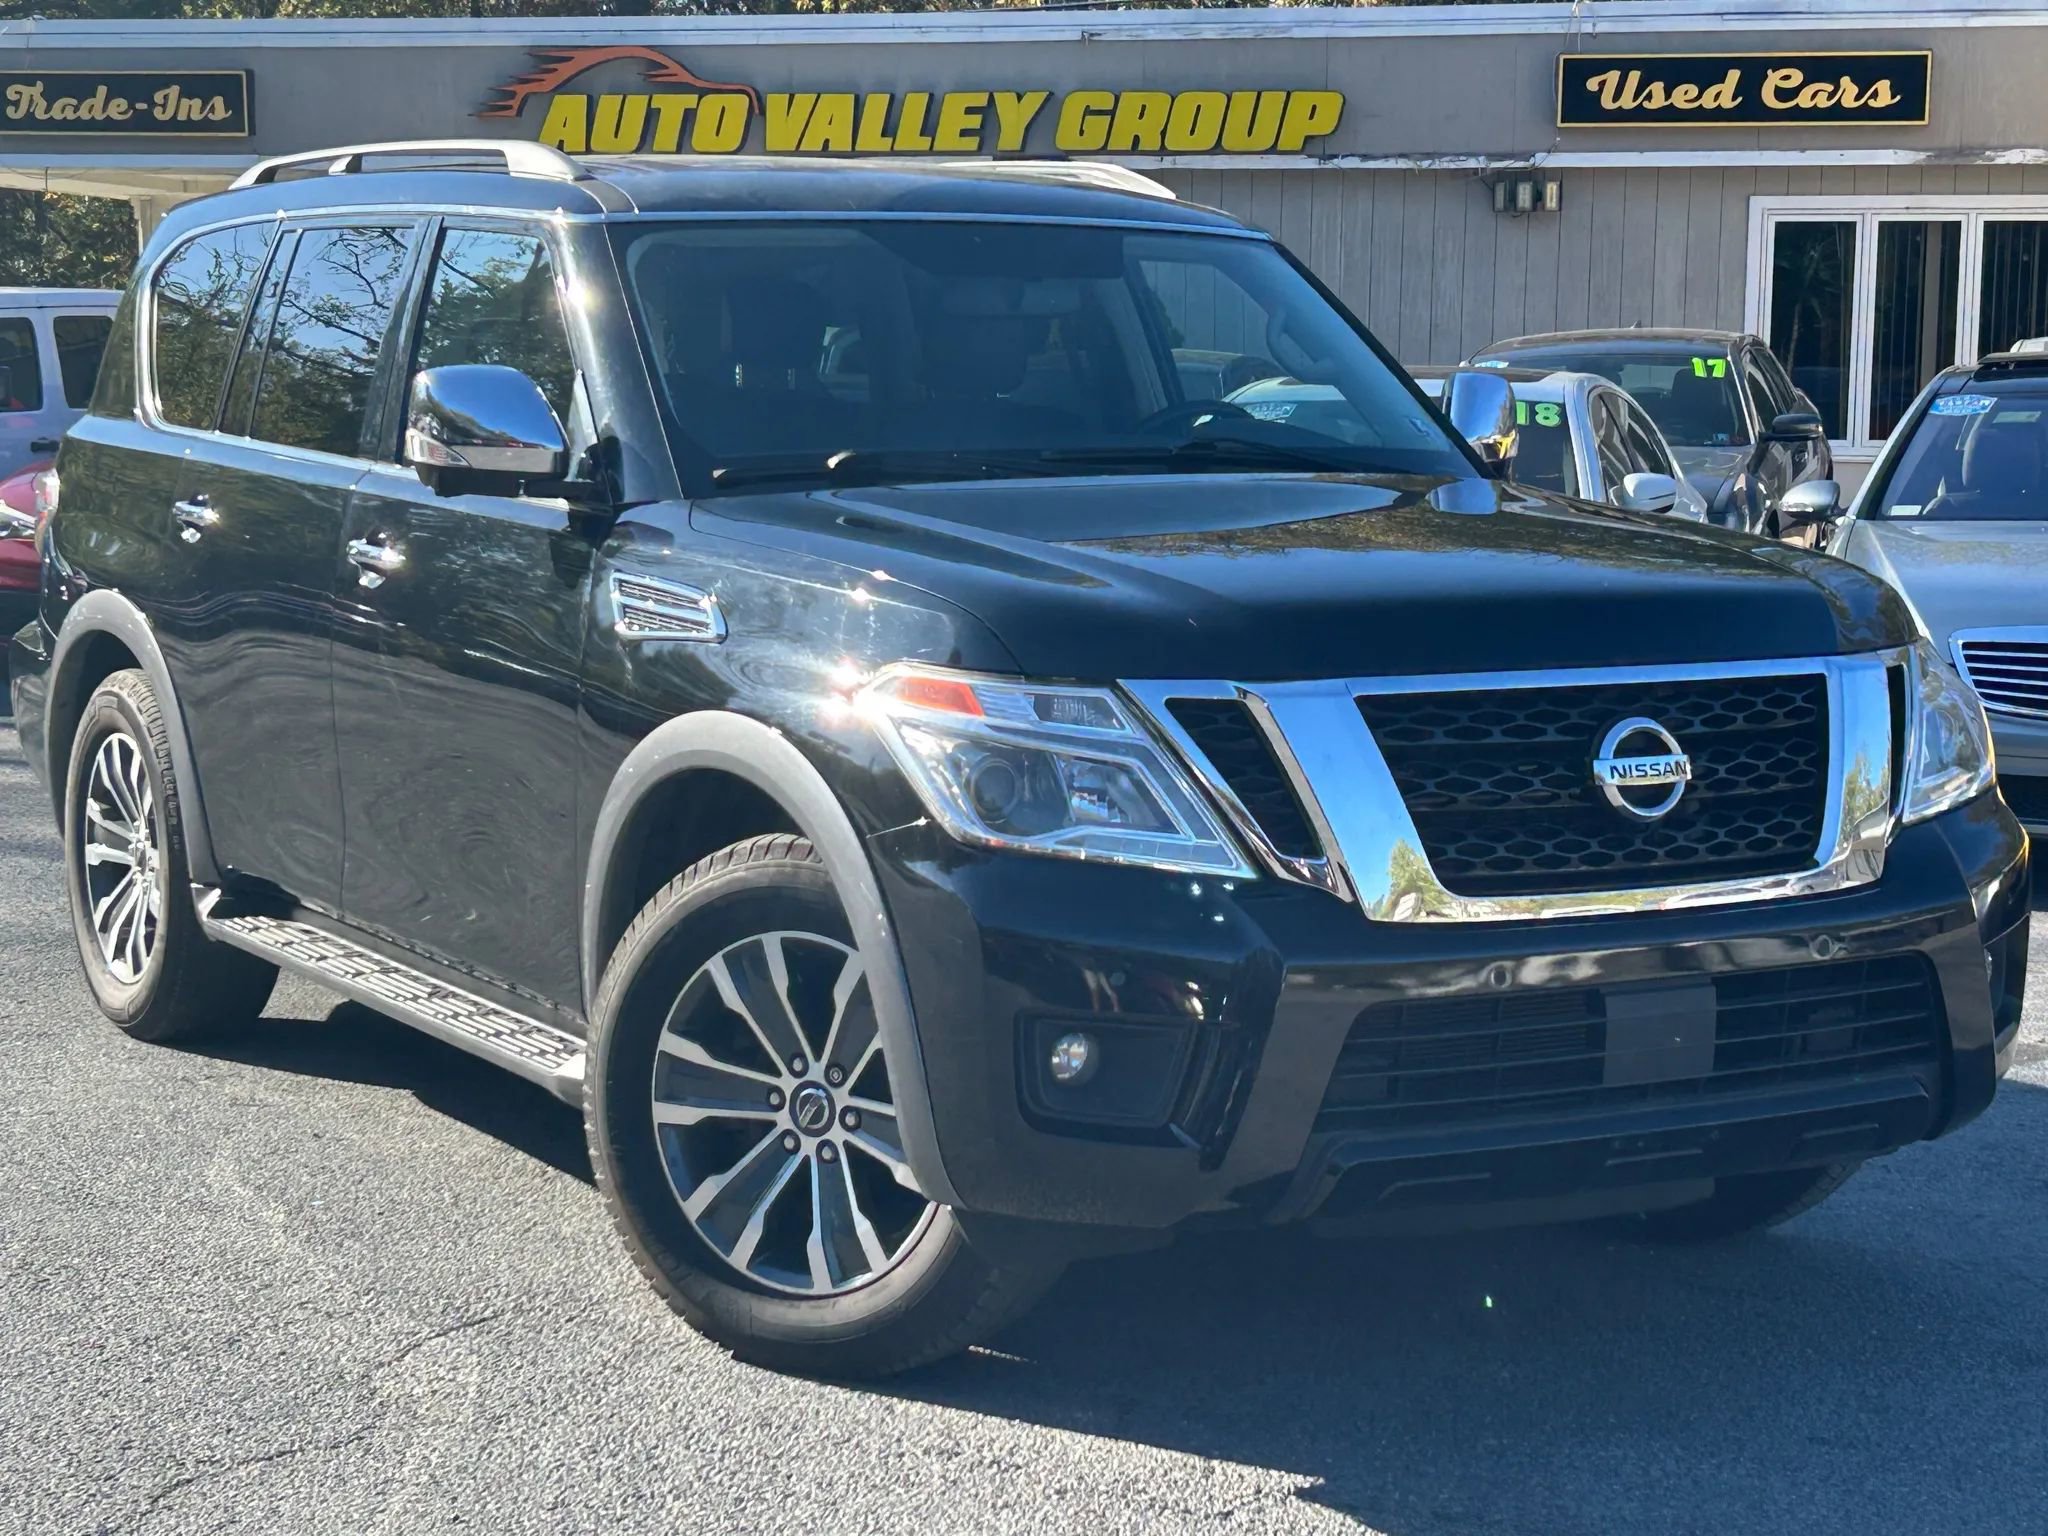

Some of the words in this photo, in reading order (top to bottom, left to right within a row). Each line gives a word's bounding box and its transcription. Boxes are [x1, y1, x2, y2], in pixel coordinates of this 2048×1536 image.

[5, 80, 233, 121] Trade-Ins
[1585, 69, 1743, 110] Used
[1761, 67, 1902, 109] Cars
[538, 93, 750, 154] AUTO
[766, 91, 1051, 152] VALLEY
[1055, 90, 1344, 152] GROUP
[1691, 357, 1727, 378] 17
[1516, 401, 1562, 427] 18
[1609, 760, 1688, 780] NISSAN
